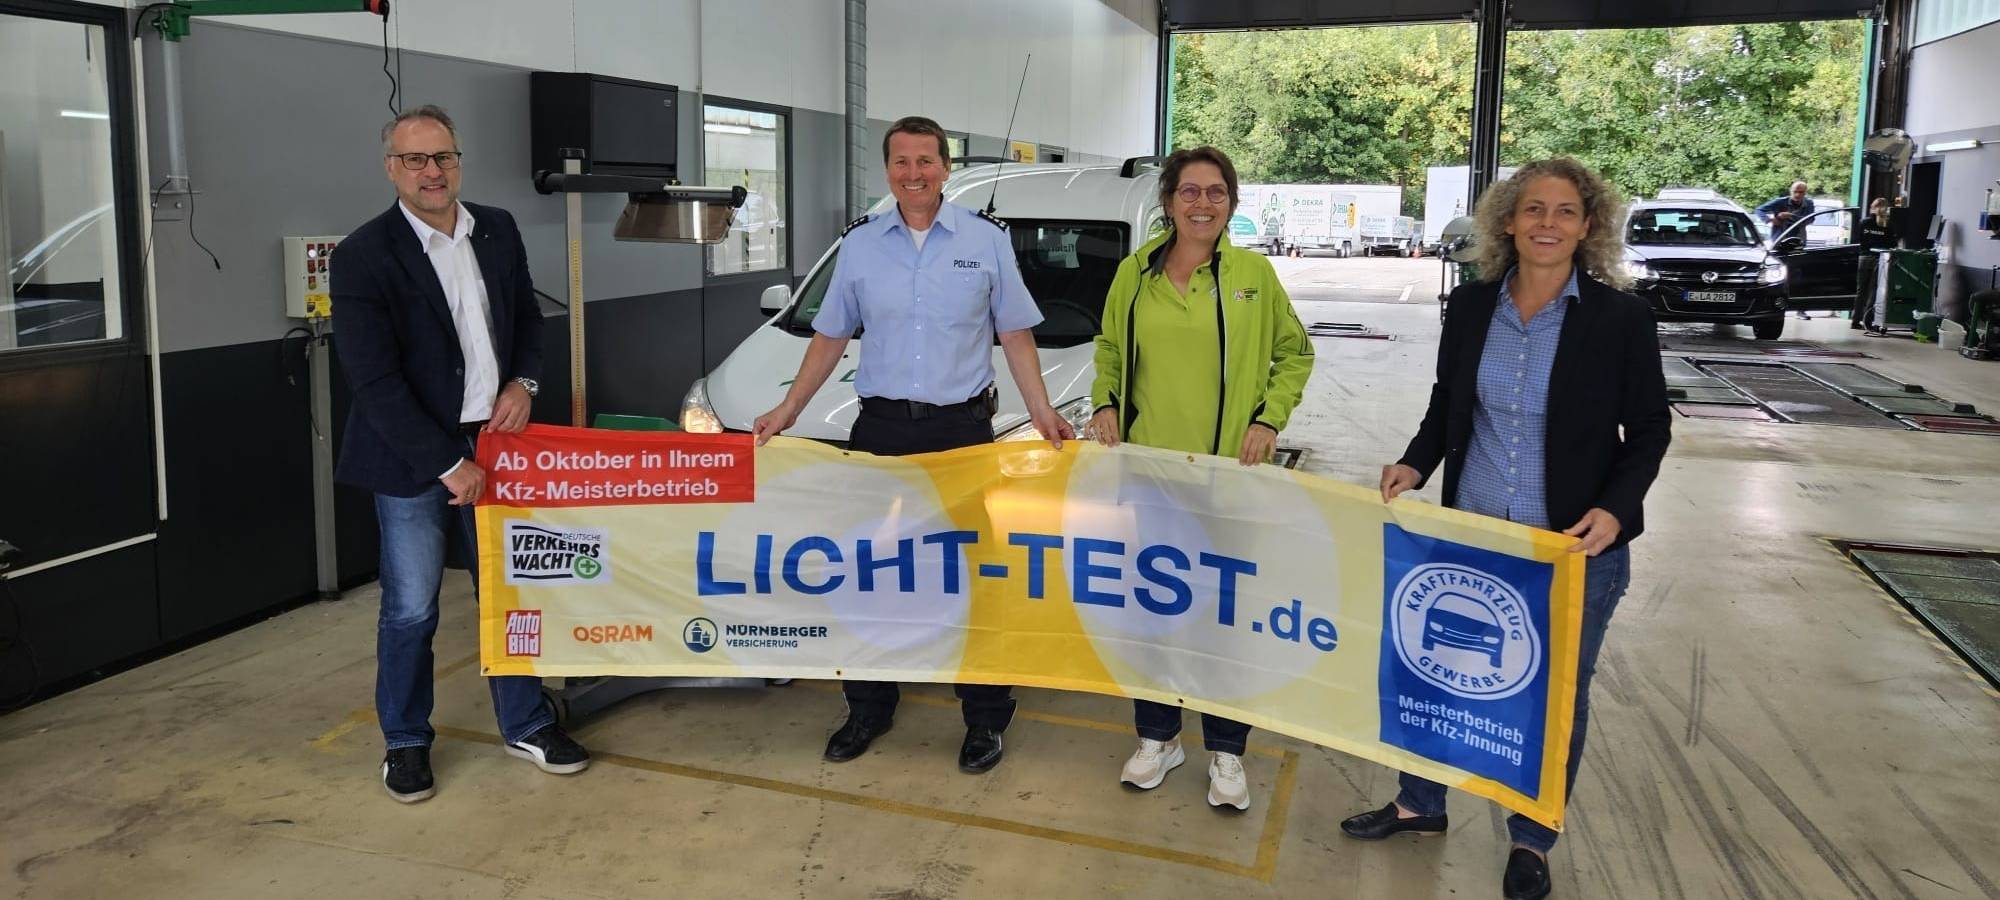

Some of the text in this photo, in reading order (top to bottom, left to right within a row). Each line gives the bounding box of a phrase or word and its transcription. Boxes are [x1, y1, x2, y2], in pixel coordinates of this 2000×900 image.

[953, 259, 981, 269] POLIZEI
[494, 450, 735, 471] Ab Oktober in Ihrem
[495, 479, 719, 501] Kfz-Meisterbetrieb
[512, 534, 600, 558] VERKEHRS
[562, 532, 601, 542] DEUTSCHE
[512, 552, 575, 571] WACHT
[695, 530, 1339, 653] LICHT-TEST.de
[1405, 572, 1523, 642] KRAFTFAHRZEUG
[506, 612, 540, 634] Auto
[573, 624, 653, 643] OSRAM
[725, 624, 828, 638] NÜRNBERGER
[508, 634, 540, 655] Bild
[725, 639, 799, 649] VERSICHERUNG
[1418, 655, 1505, 689] GEWERBE
[1398, 695, 1524, 745] Meisterbetrieb
[1399, 711, 1524, 766] der Kfz-Innung
